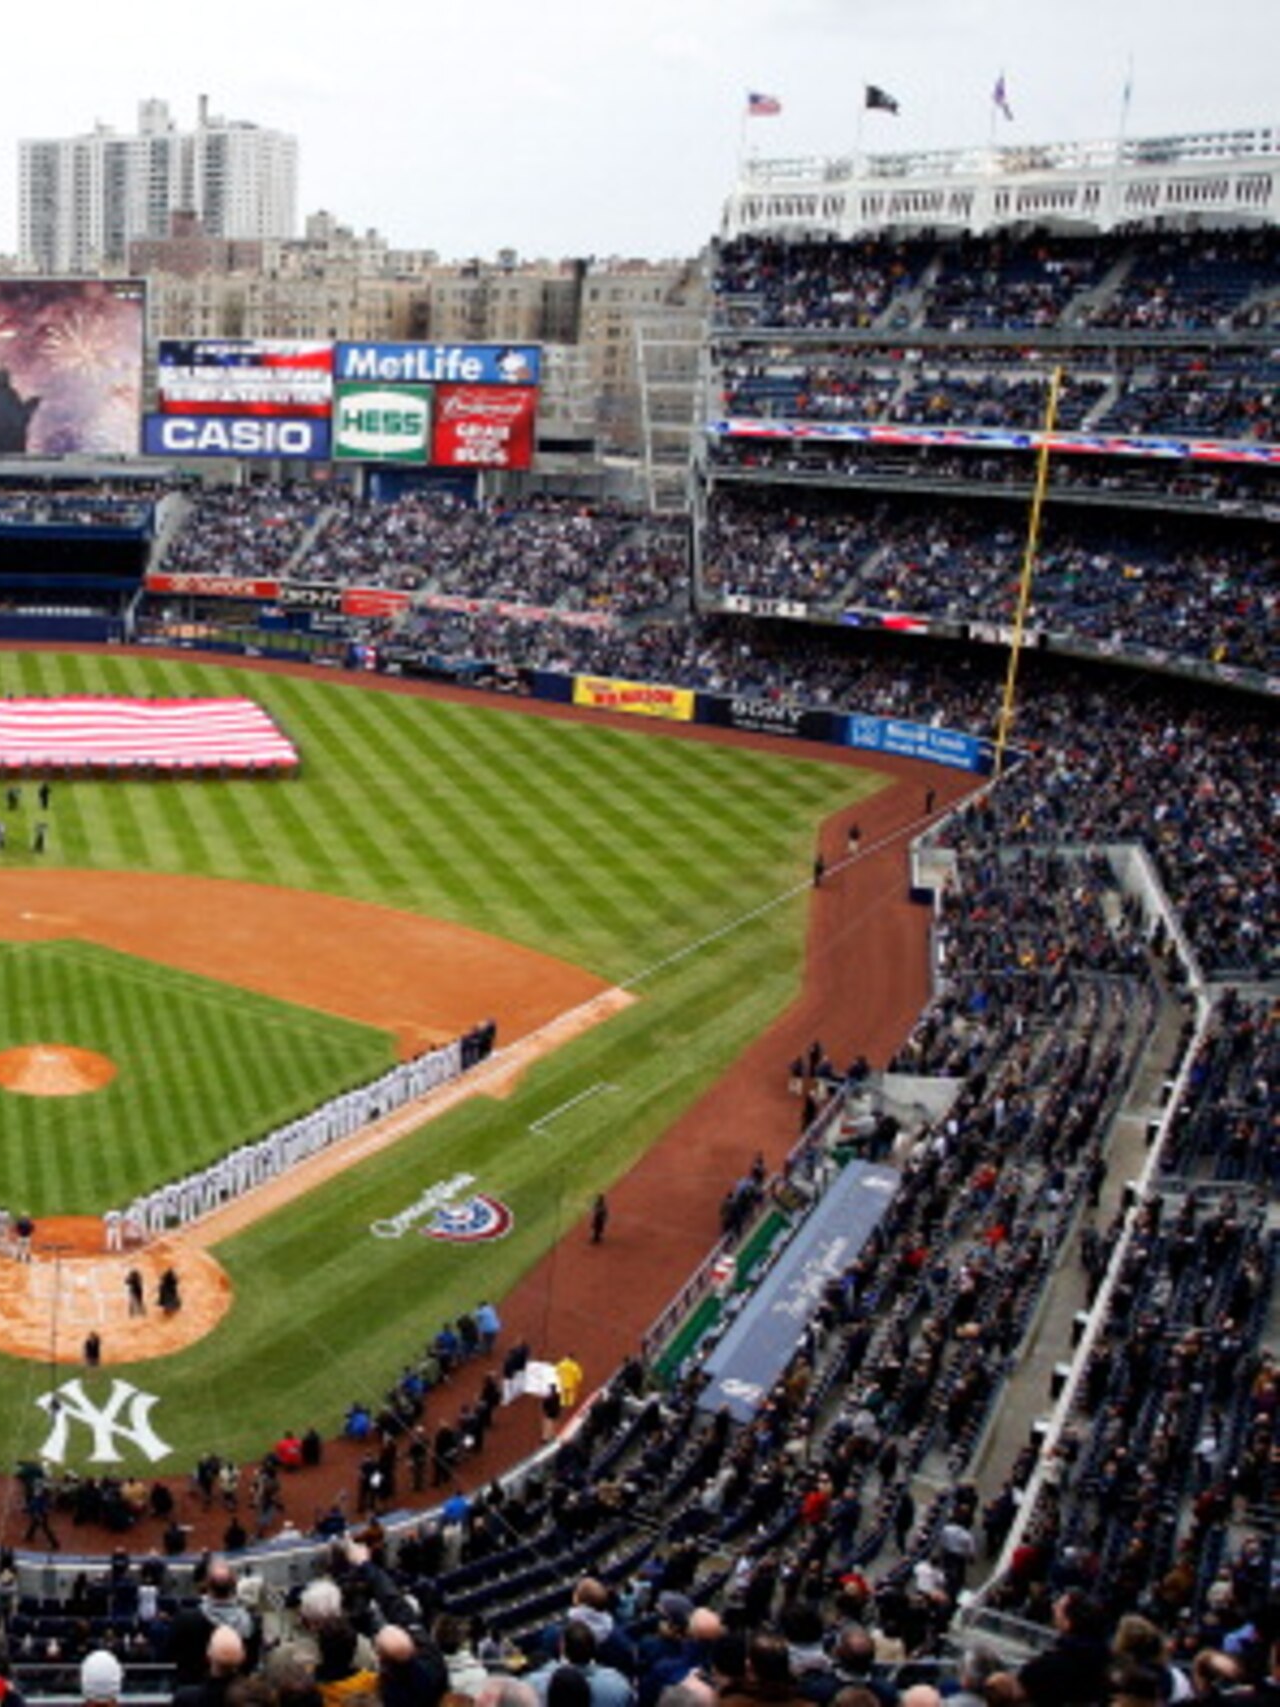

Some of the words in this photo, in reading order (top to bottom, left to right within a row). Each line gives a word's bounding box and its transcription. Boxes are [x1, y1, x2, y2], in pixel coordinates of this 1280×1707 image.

[344, 346, 483, 381] MetLife
[161, 418, 314, 454] CASIO
[342, 408, 423, 437] HESS
[731, 698, 804, 723] SONY
[35, 1378, 174, 1464] NY
